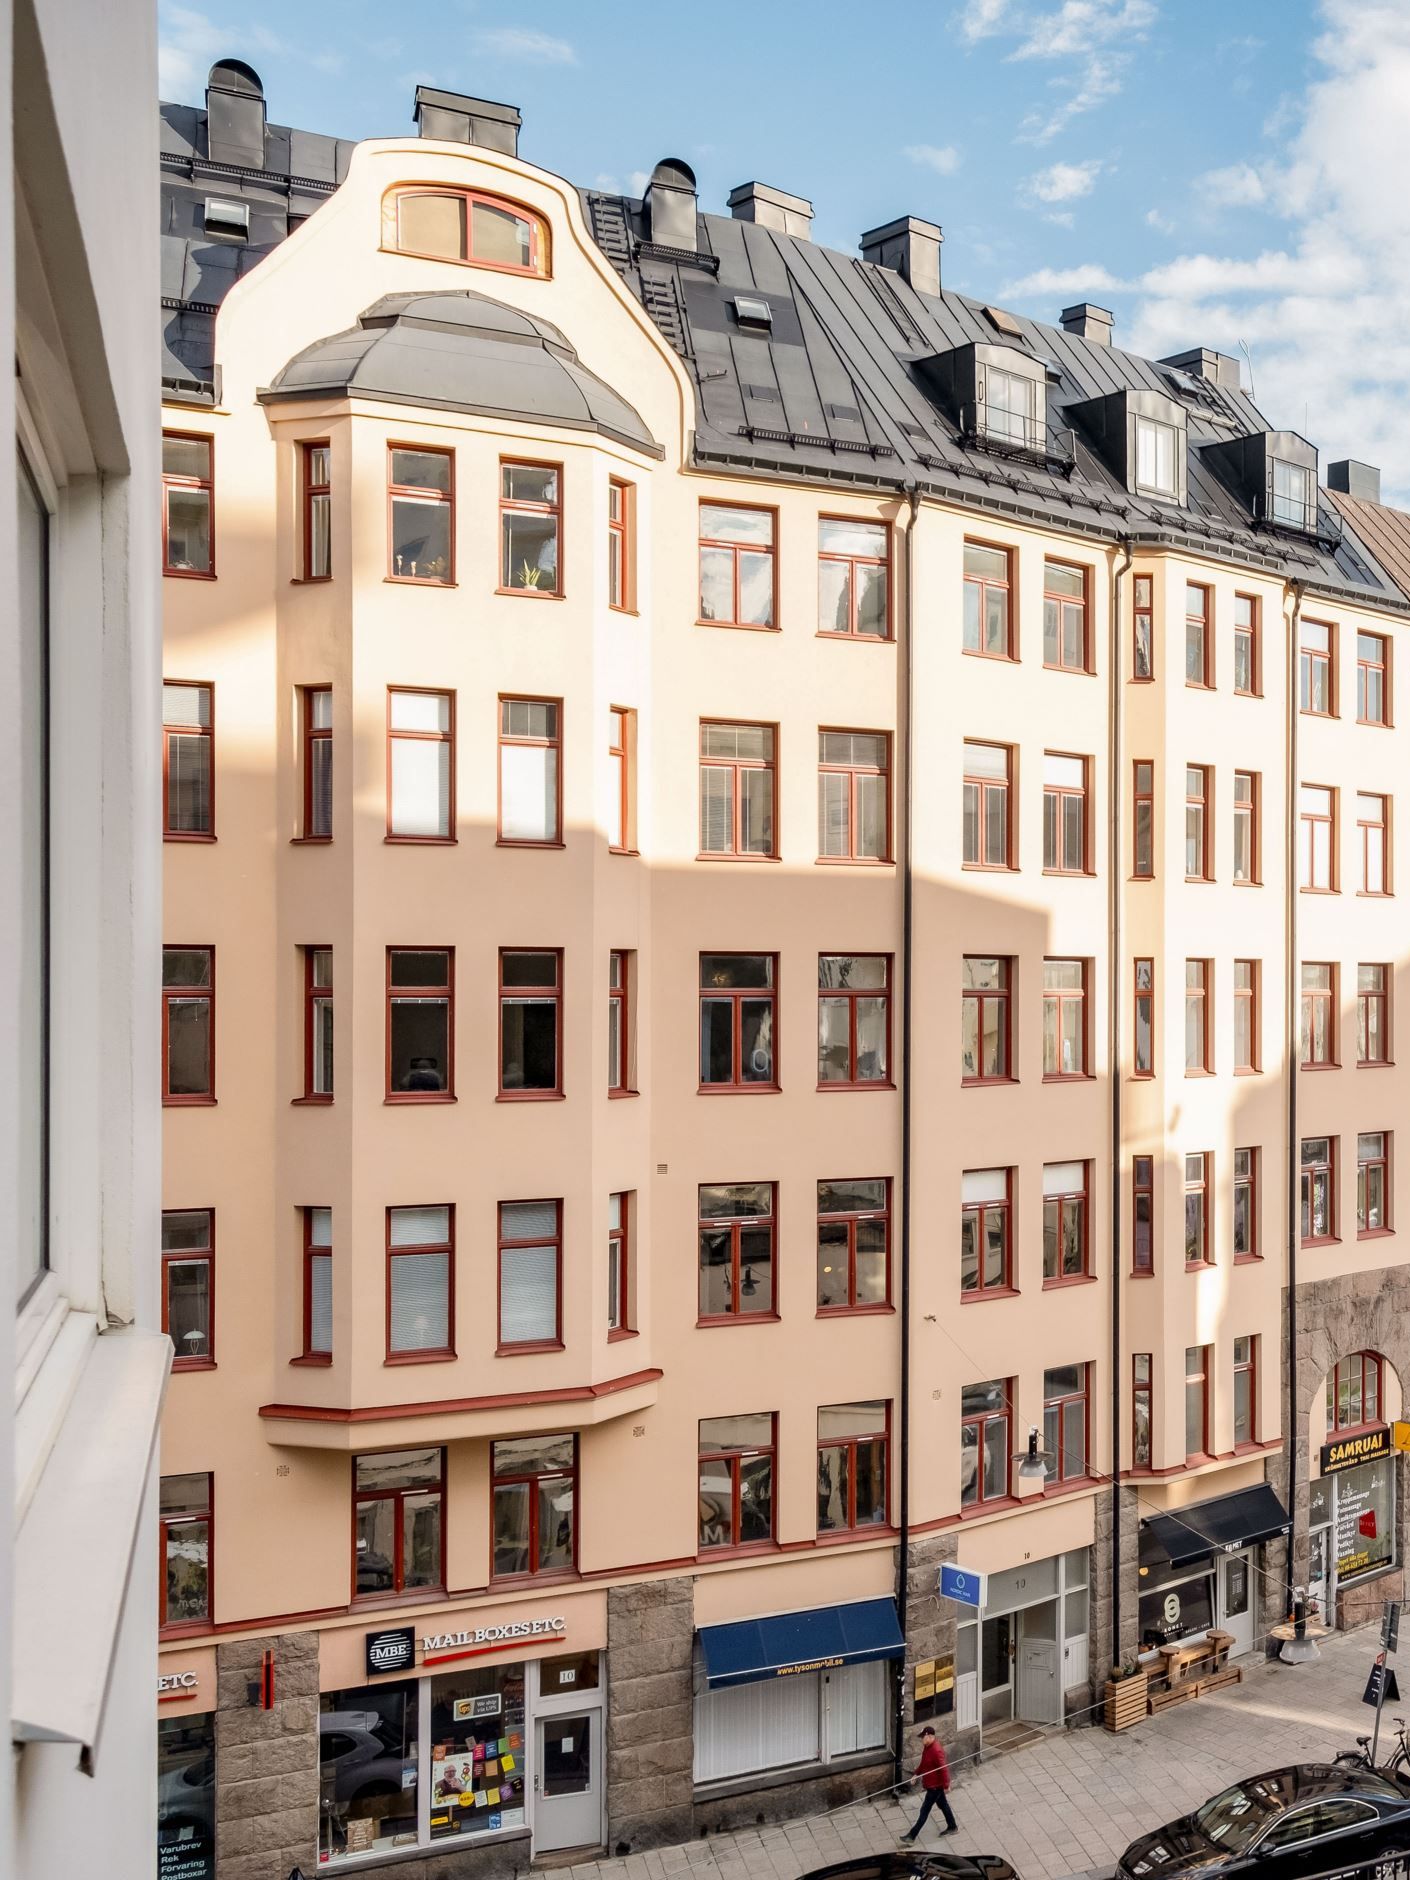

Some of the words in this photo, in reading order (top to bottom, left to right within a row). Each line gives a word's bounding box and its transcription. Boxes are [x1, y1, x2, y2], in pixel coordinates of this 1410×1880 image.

[1329, 1432, 1383, 1463] SAMRUAI
[1024, 1552, 1031, 1560] 10
[1015, 1578, 1026, 1590] 10
[422, 1631, 473, 1651] MAIL
[374, 1645, 408, 1659] MBE
[561, 1671, 575, 1682] 10
[160, 1842, 202, 1855] Varubrev
[161, 1855, 180, 1863] Rek
[161, 1860, 206, 1873] Förvaring
[161, 1869, 207, 1880] Postboxar
